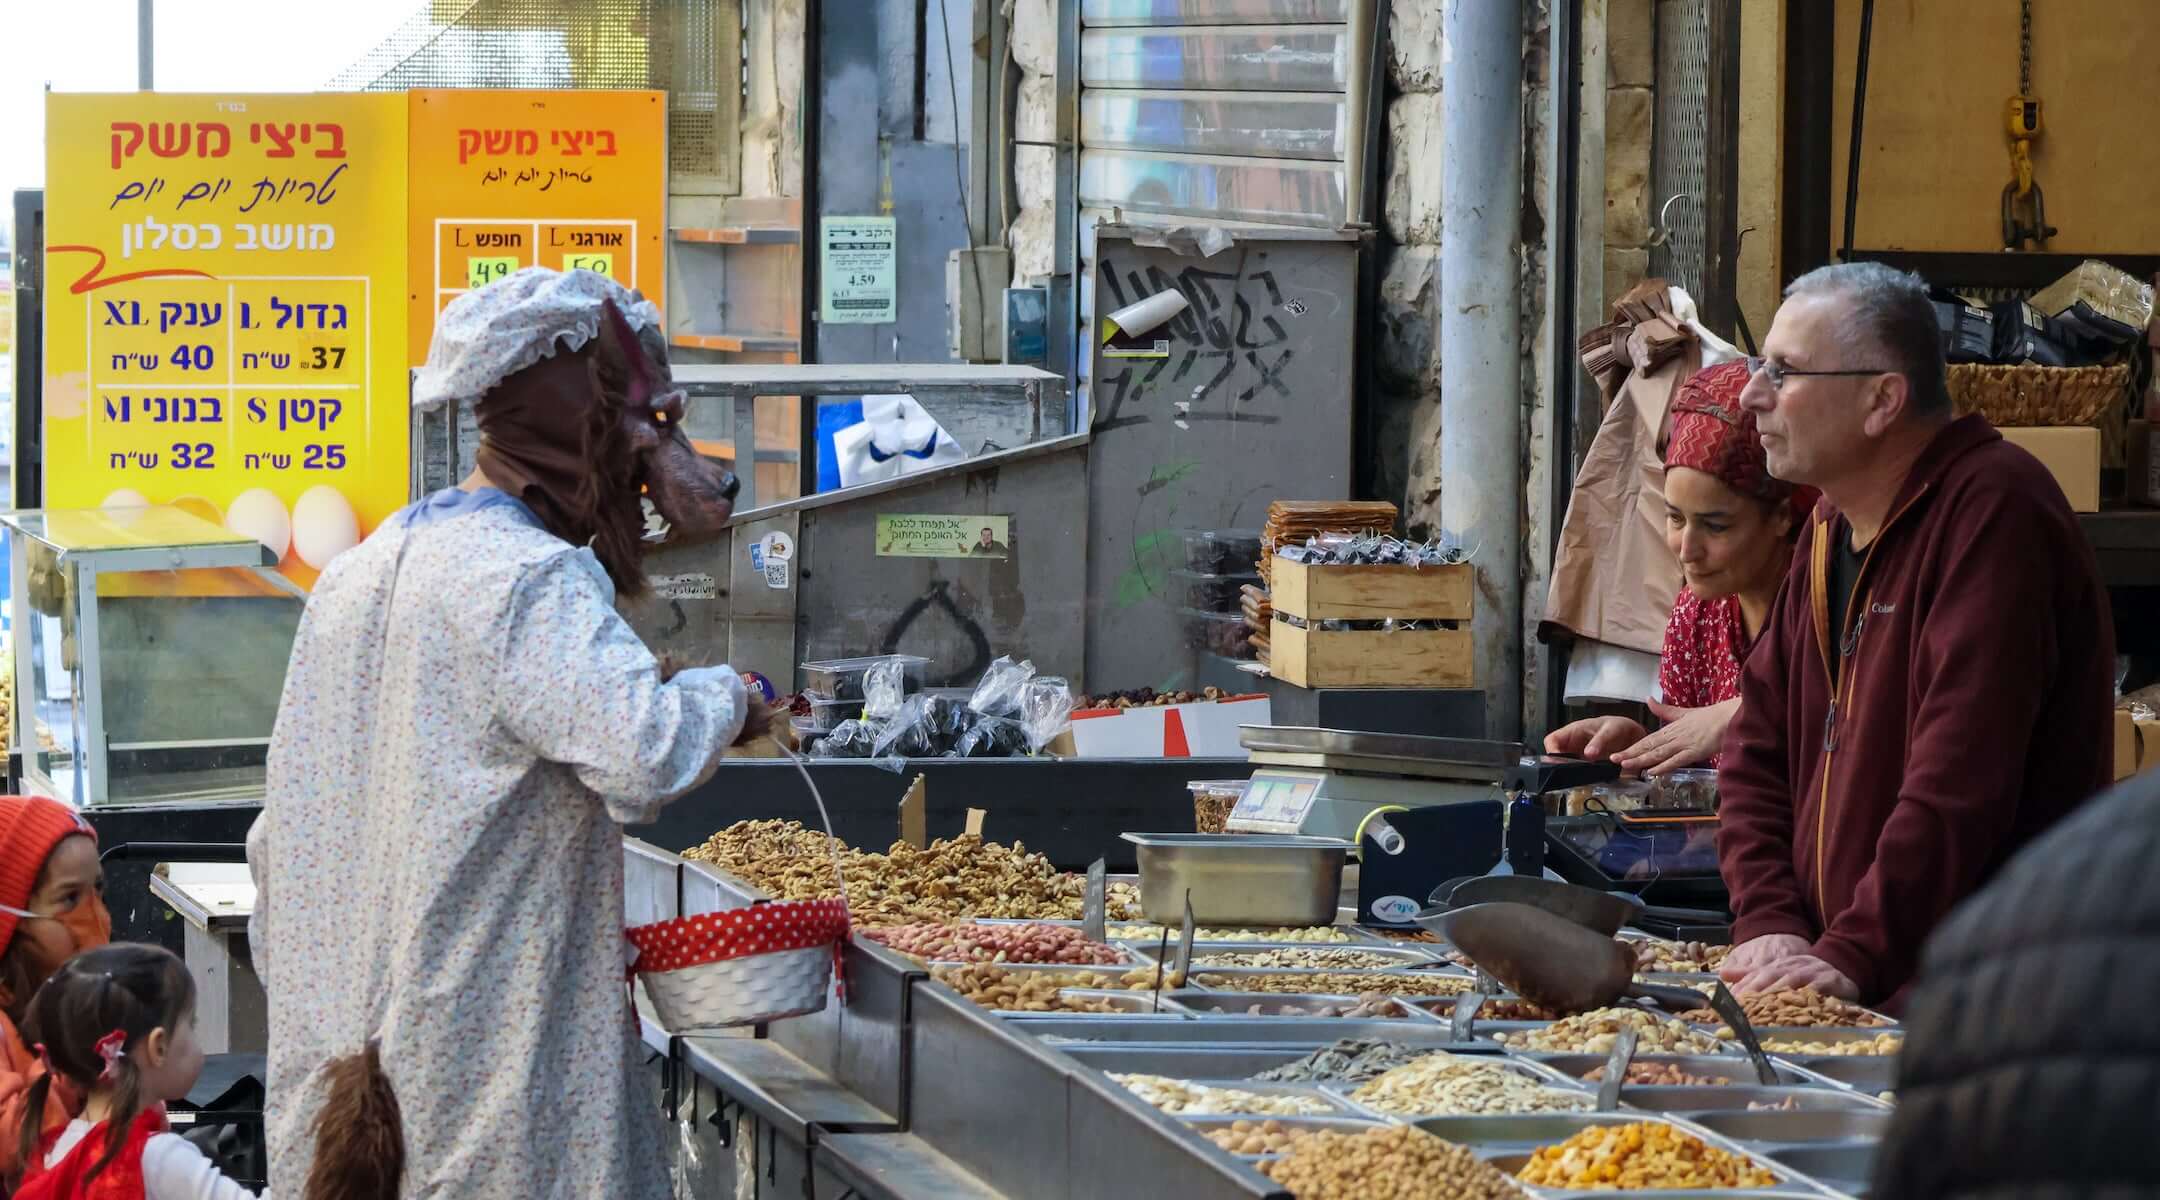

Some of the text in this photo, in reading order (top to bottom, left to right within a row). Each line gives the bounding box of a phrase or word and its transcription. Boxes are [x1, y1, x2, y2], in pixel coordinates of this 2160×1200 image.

[110, 122, 348, 170] ביצי משק
[458, 128, 618, 165] ביצי משק
[109, 163, 348, 213] טריות יום יום
[481, 166, 593, 192] טריות יום יום
[121, 215, 336, 259] מושב כסלון
[455, 228, 522, 248] חופש L
[549, 227, 624, 247] אורגני L
[476, 262, 508, 284] 49
[848, 274, 876, 287] 4.59
[103, 300, 222, 334] ענק XL
[239, 296, 348, 330] גדול L
[170, 345, 214, 371] 40
[103, 396, 223, 423] בנוני M
[247, 396, 342, 431] קטן S
[170, 443, 215, 470] 32
[303, 444, 346, 470] 25
[947, 519, 960, 529] אל
[955, 530, 968, 540] אל
